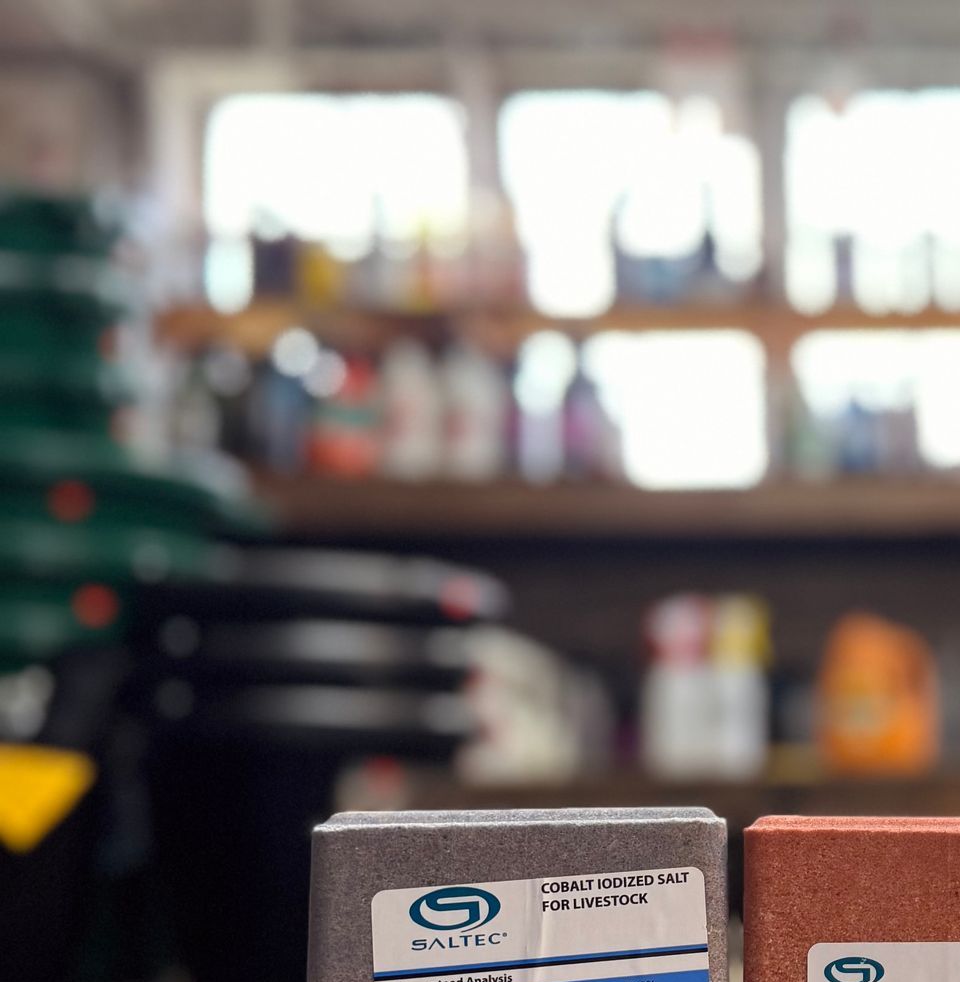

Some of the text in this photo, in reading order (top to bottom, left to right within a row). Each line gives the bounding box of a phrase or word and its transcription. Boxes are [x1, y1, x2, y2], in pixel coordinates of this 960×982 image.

[540, 871, 689, 893] COBALT IODIZED SALT
[542, 892, 648, 911] FOR LIVESTOCK
